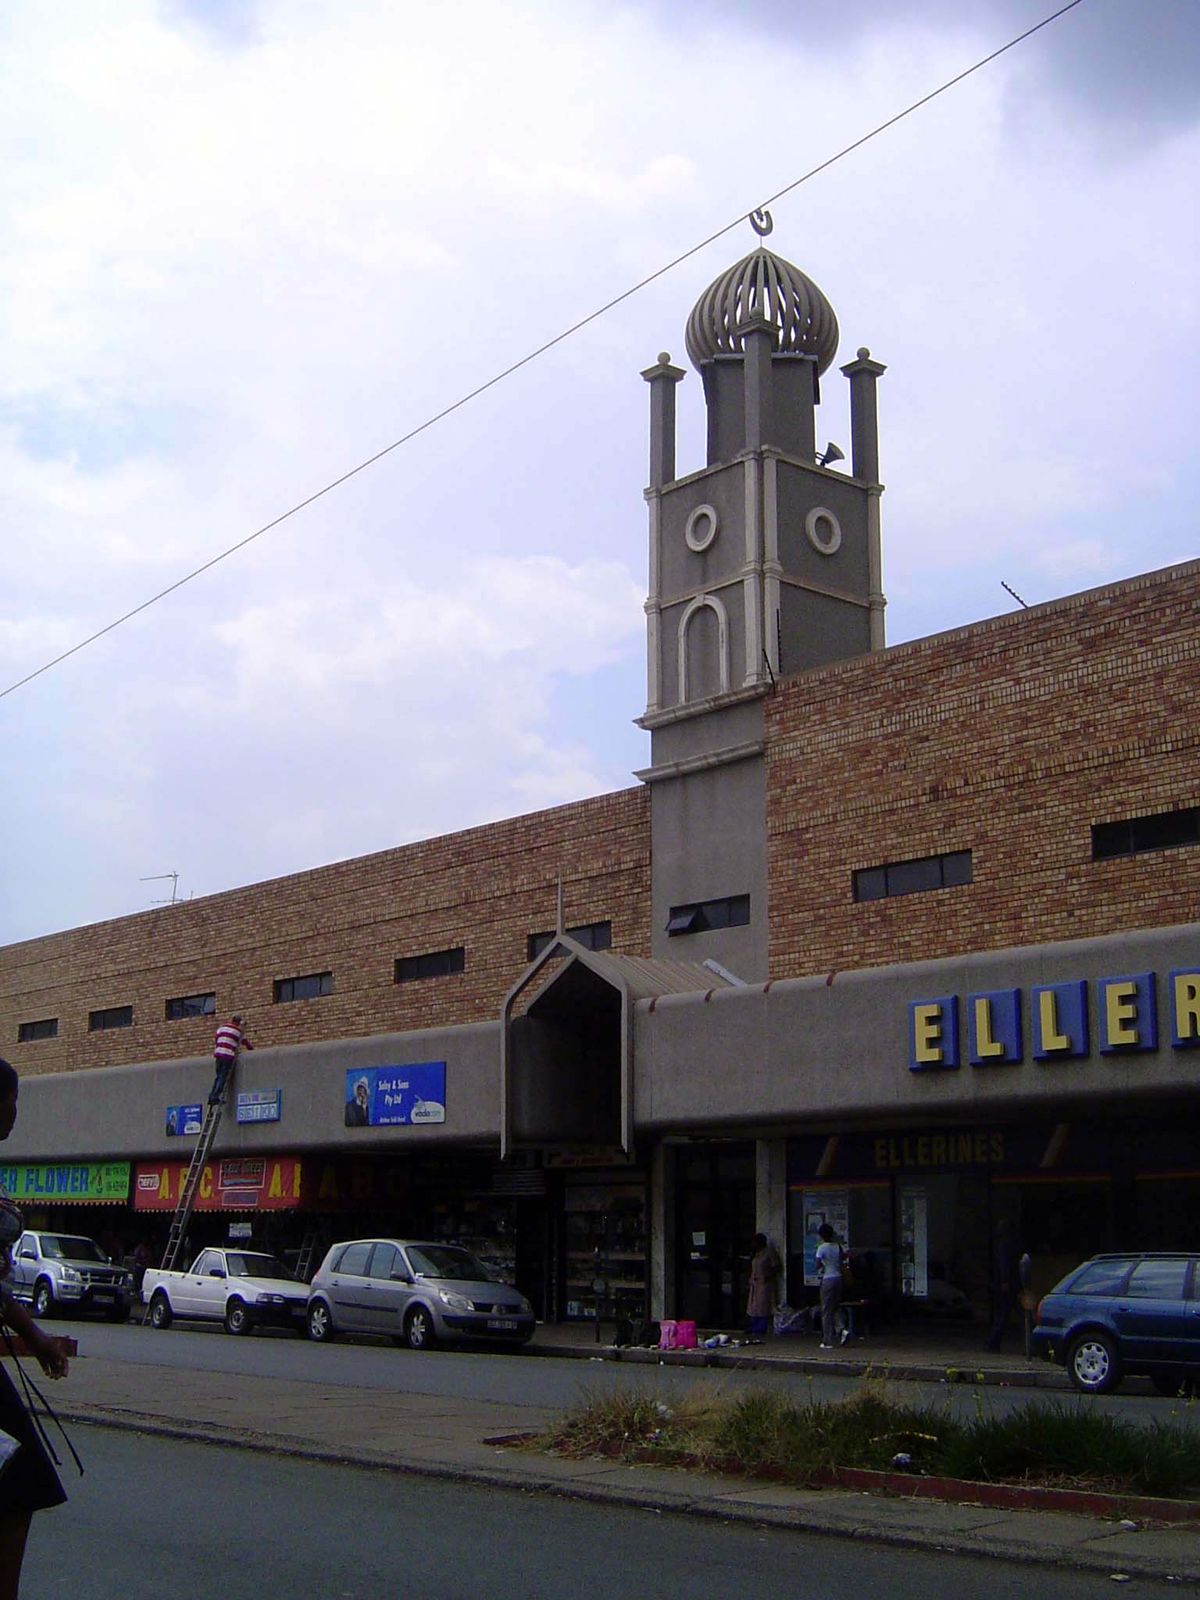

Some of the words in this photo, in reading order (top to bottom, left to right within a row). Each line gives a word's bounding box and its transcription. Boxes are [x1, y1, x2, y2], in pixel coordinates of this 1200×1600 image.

[914, 973, 1200, 1063] ELLER
[873, 1134, 1005, 1168] ELLERINES
[25, 1167, 89, 1193] FLOWER
